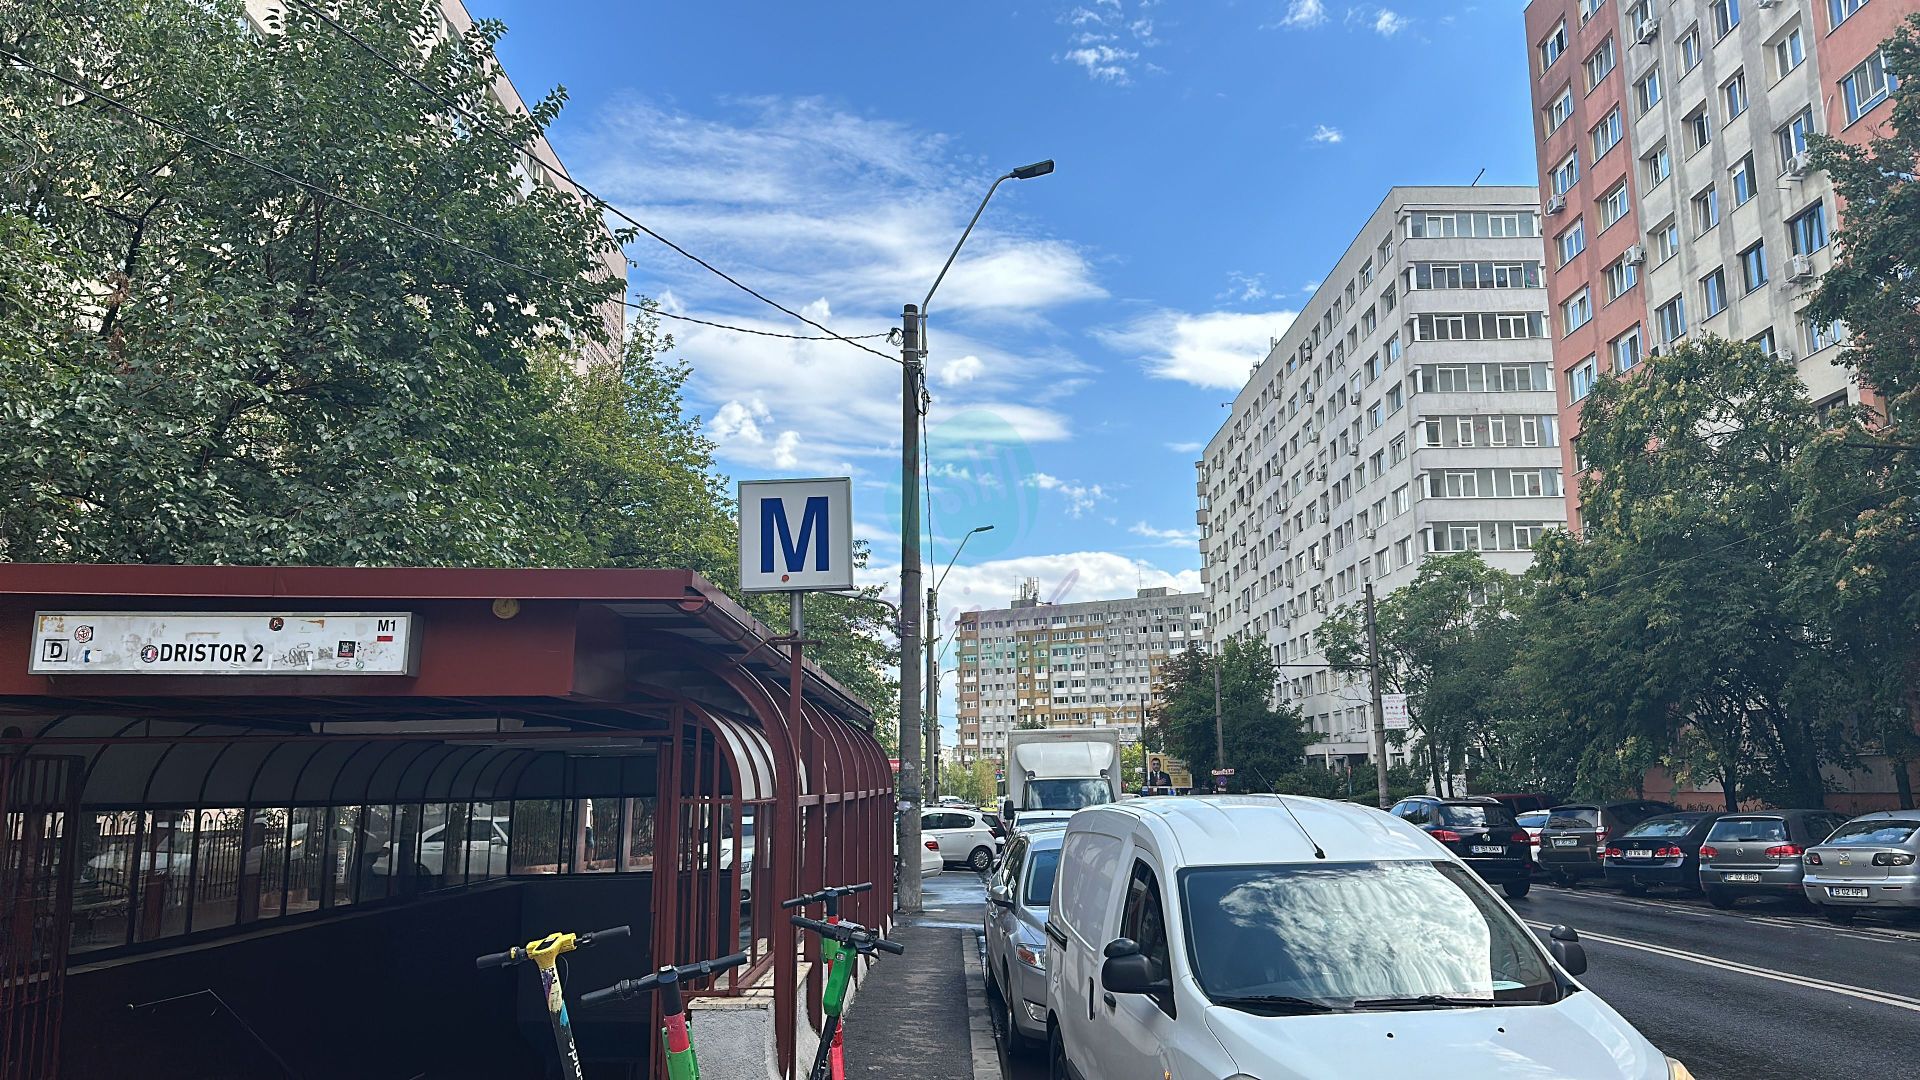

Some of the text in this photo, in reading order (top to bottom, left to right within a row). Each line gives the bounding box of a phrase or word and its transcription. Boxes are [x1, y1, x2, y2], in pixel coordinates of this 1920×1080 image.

[761, 496, 829, 573] M
[378, 619, 397, 632] M1
[50, 642, 63, 658] D
[159, 643, 247, 662] DRISTOR
[252, 643, 264, 662] 2
[1841, 888, 1851, 896] 02
